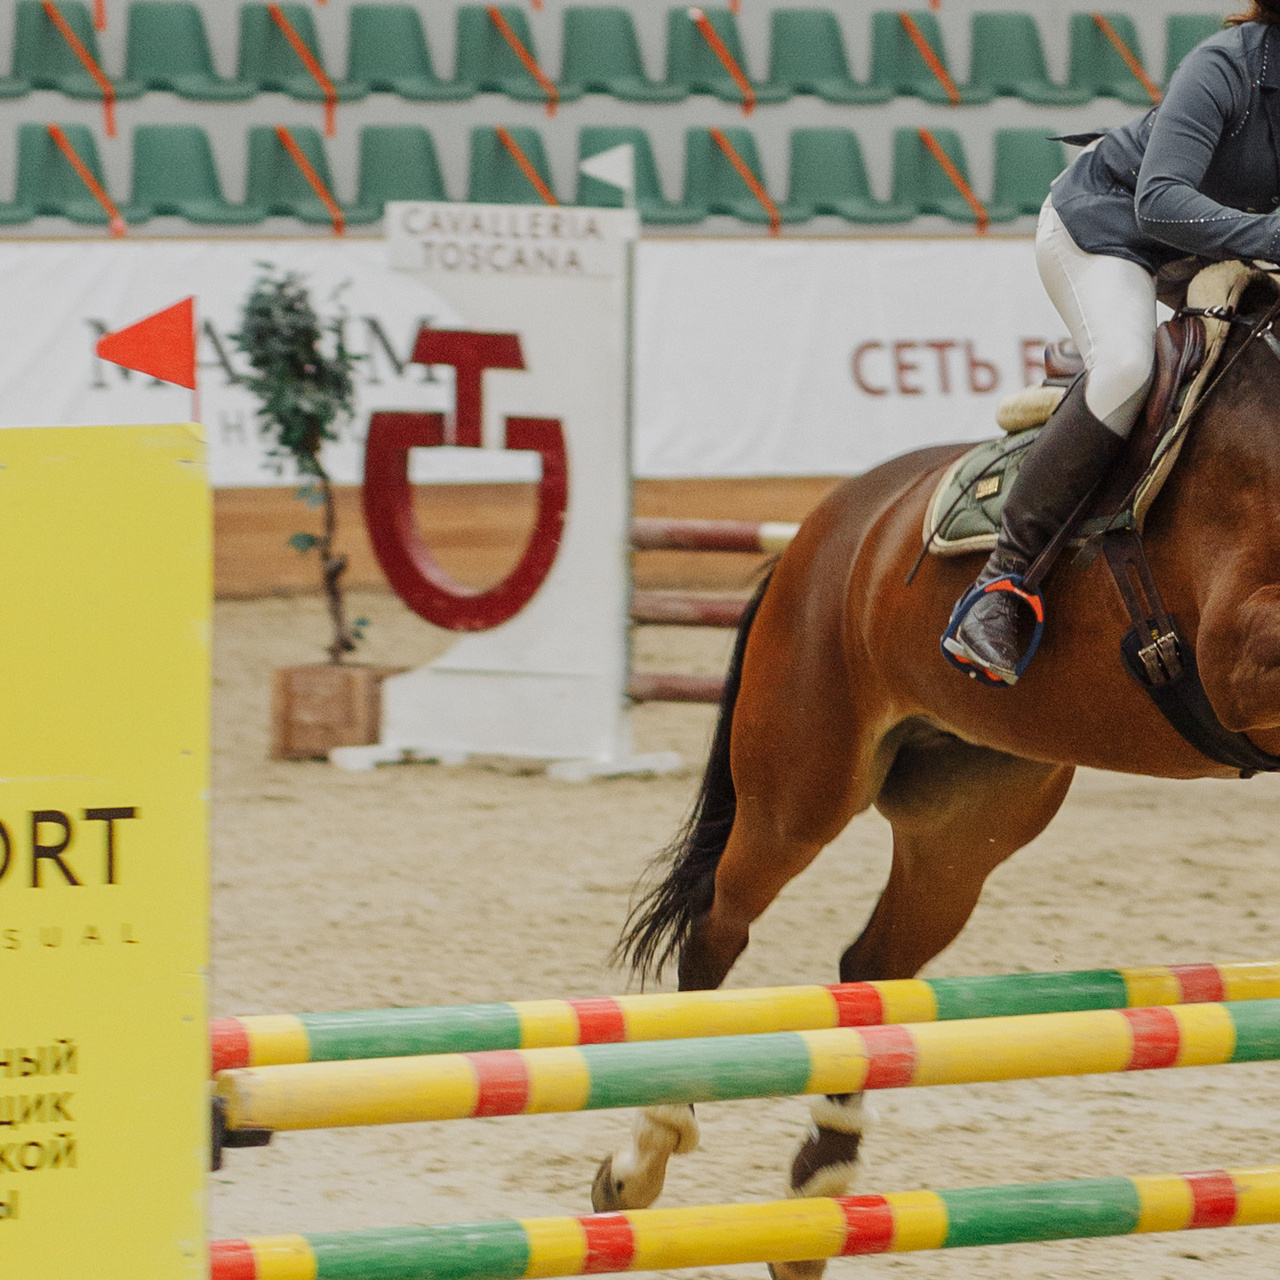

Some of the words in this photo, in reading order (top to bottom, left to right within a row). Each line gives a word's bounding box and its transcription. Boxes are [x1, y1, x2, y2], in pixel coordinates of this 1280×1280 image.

[404, 206, 602, 239] CAVALLERIA
[421, 240, 582, 272] TOSCANA
[850, 339, 1001, 396] СЕТЬ
[0, 806, 140, 889] RT
